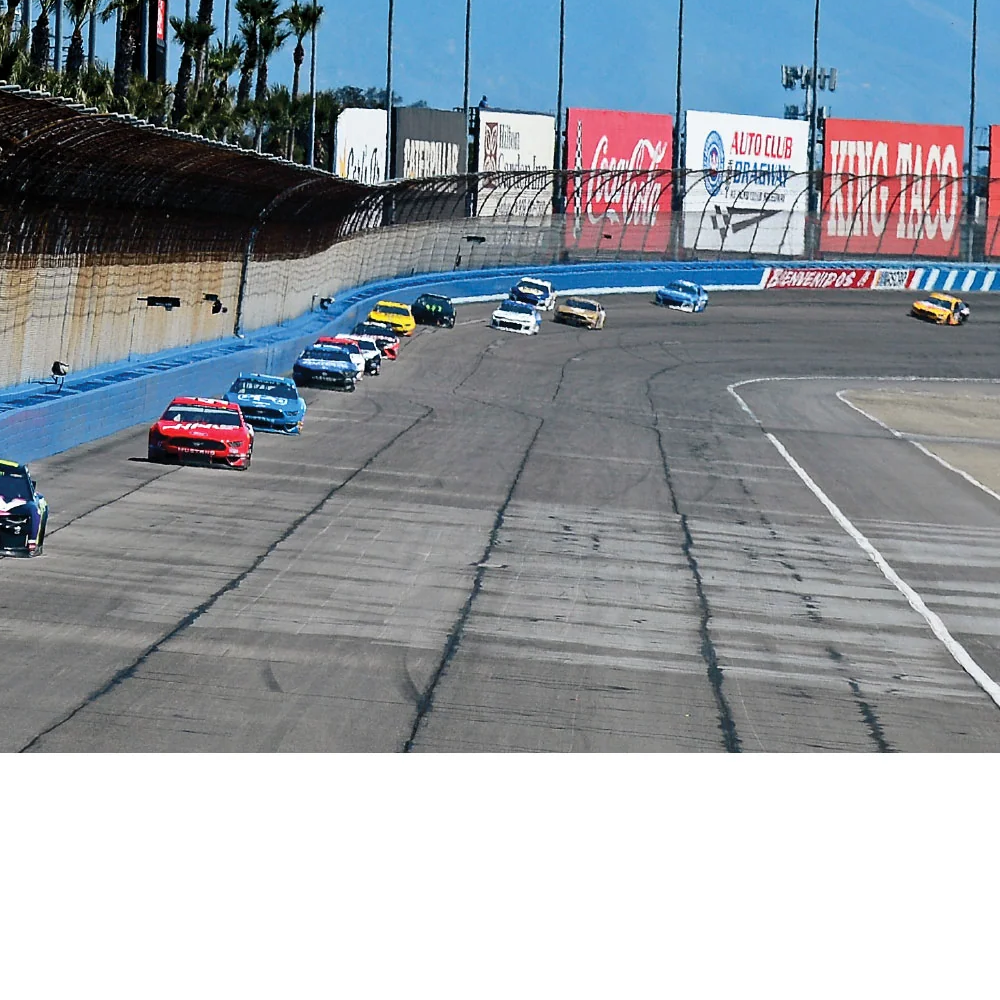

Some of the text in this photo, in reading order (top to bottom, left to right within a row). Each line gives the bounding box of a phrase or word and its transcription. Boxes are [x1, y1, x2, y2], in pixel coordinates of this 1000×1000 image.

[730, 131, 793, 160] AUTO CLUB
[827, 140, 889, 237] KING
[896, 142, 958, 242] TACO
